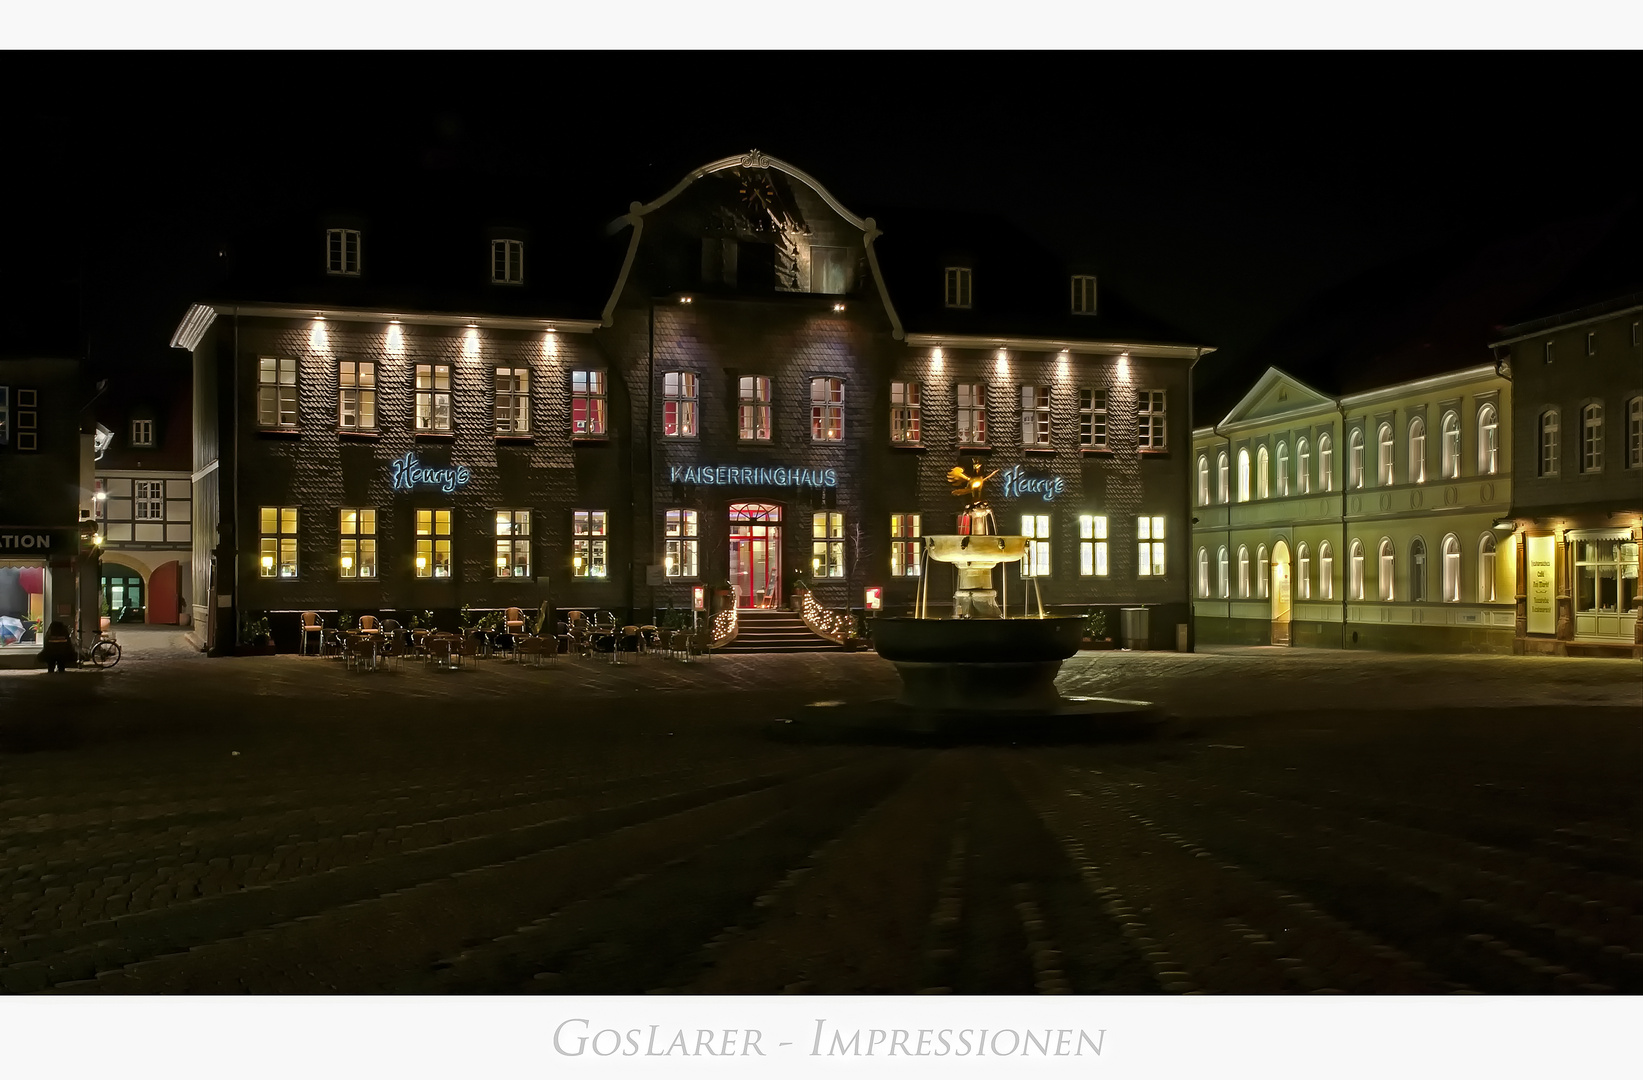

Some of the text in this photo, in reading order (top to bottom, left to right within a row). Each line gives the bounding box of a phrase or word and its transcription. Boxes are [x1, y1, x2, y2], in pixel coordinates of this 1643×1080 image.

[393, 452, 469, 492] Henry's
[671, 466, 837, 487] KAISERRINGHAUS
[1004, 464, 1064, 501] Henry's
[0, 535, 50, 548] TION
